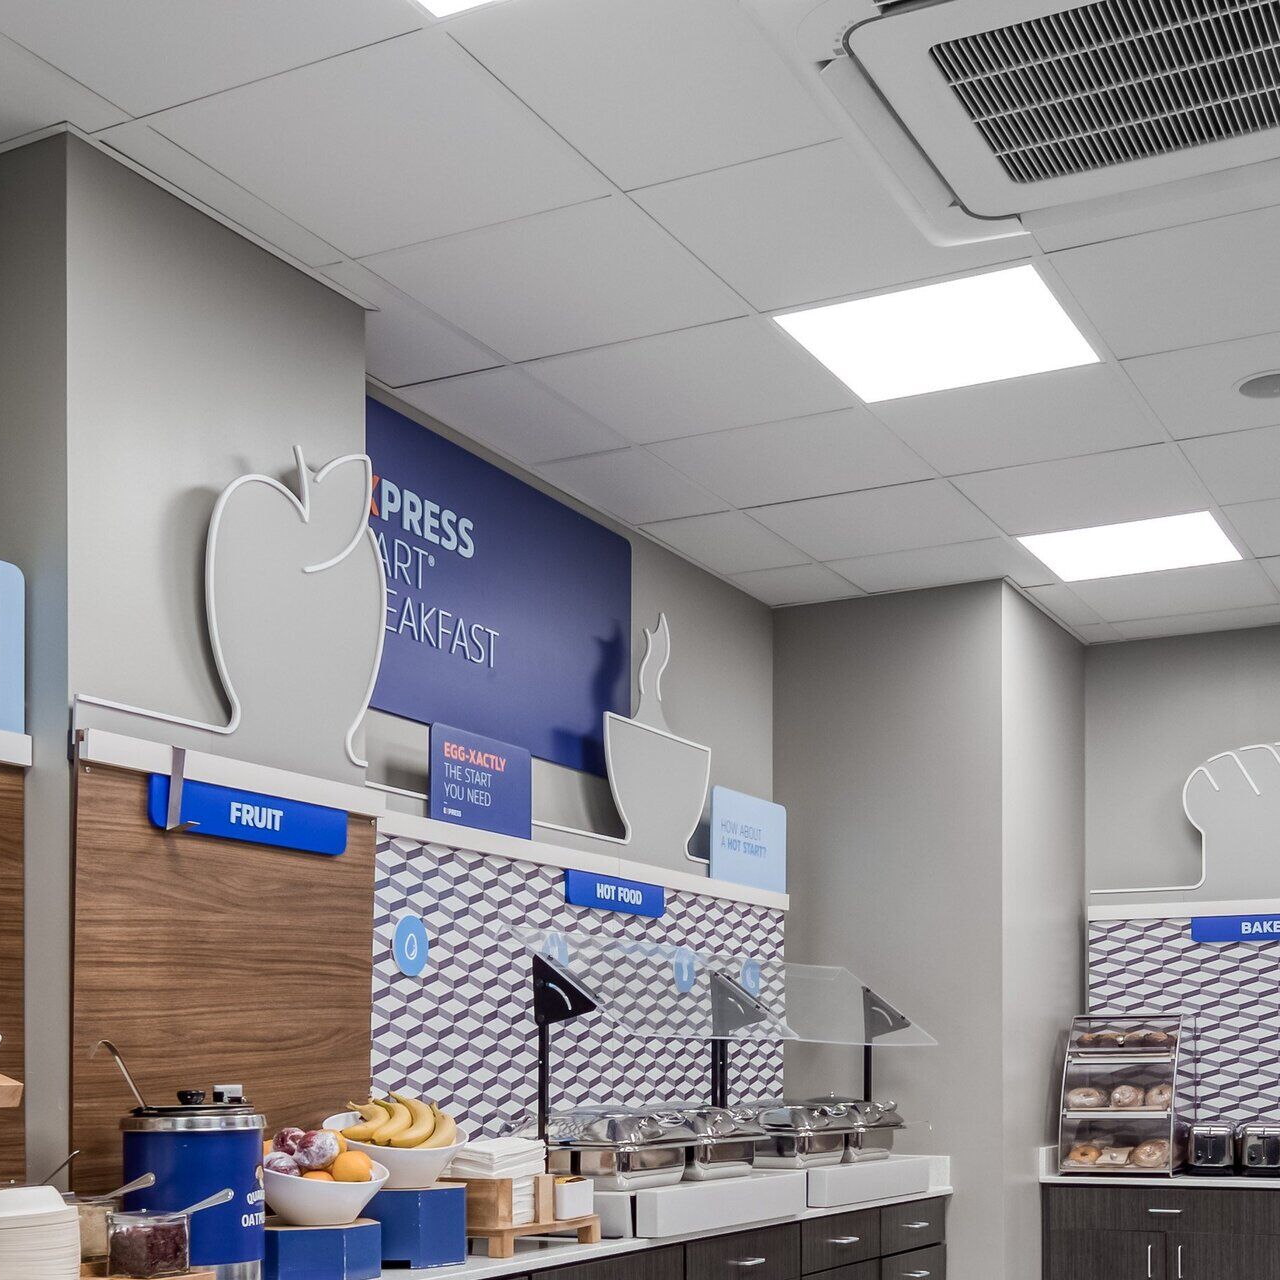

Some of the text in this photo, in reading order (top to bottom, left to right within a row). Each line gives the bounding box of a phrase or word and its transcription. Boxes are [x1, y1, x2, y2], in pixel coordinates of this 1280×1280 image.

[443, 741, 507, 772] EGG-XACTLY
[444, 762, 492, 788] THE START
[444, 782, 491, 807] YOU NEED
[230, 801, 283, 831] FRUIT
[721, 819, 762, 841] HOW ABOUT
[727, 838, 741, 852] HOT
[743, 841, 767, 858] START?
[596, 883, 643, 905] HOT FOOD
